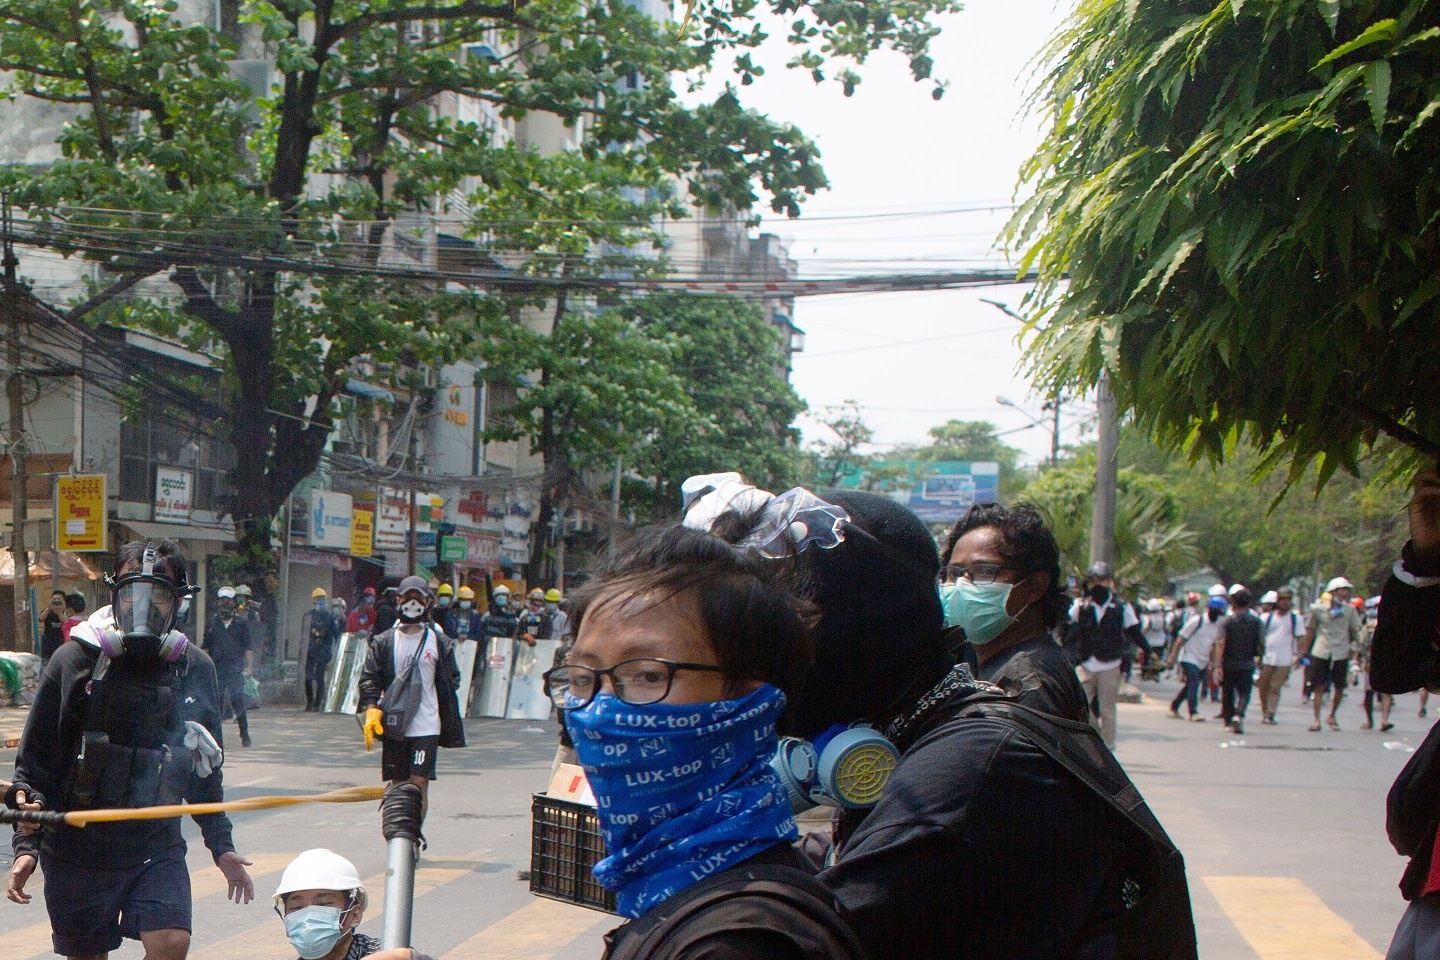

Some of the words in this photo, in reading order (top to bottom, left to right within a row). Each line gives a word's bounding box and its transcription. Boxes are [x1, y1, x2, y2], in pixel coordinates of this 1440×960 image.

[615, 712, 702, 728] LUX-top
[413, 749, 426, 766] 10
[625, 758, 702, 787] LUX-top
